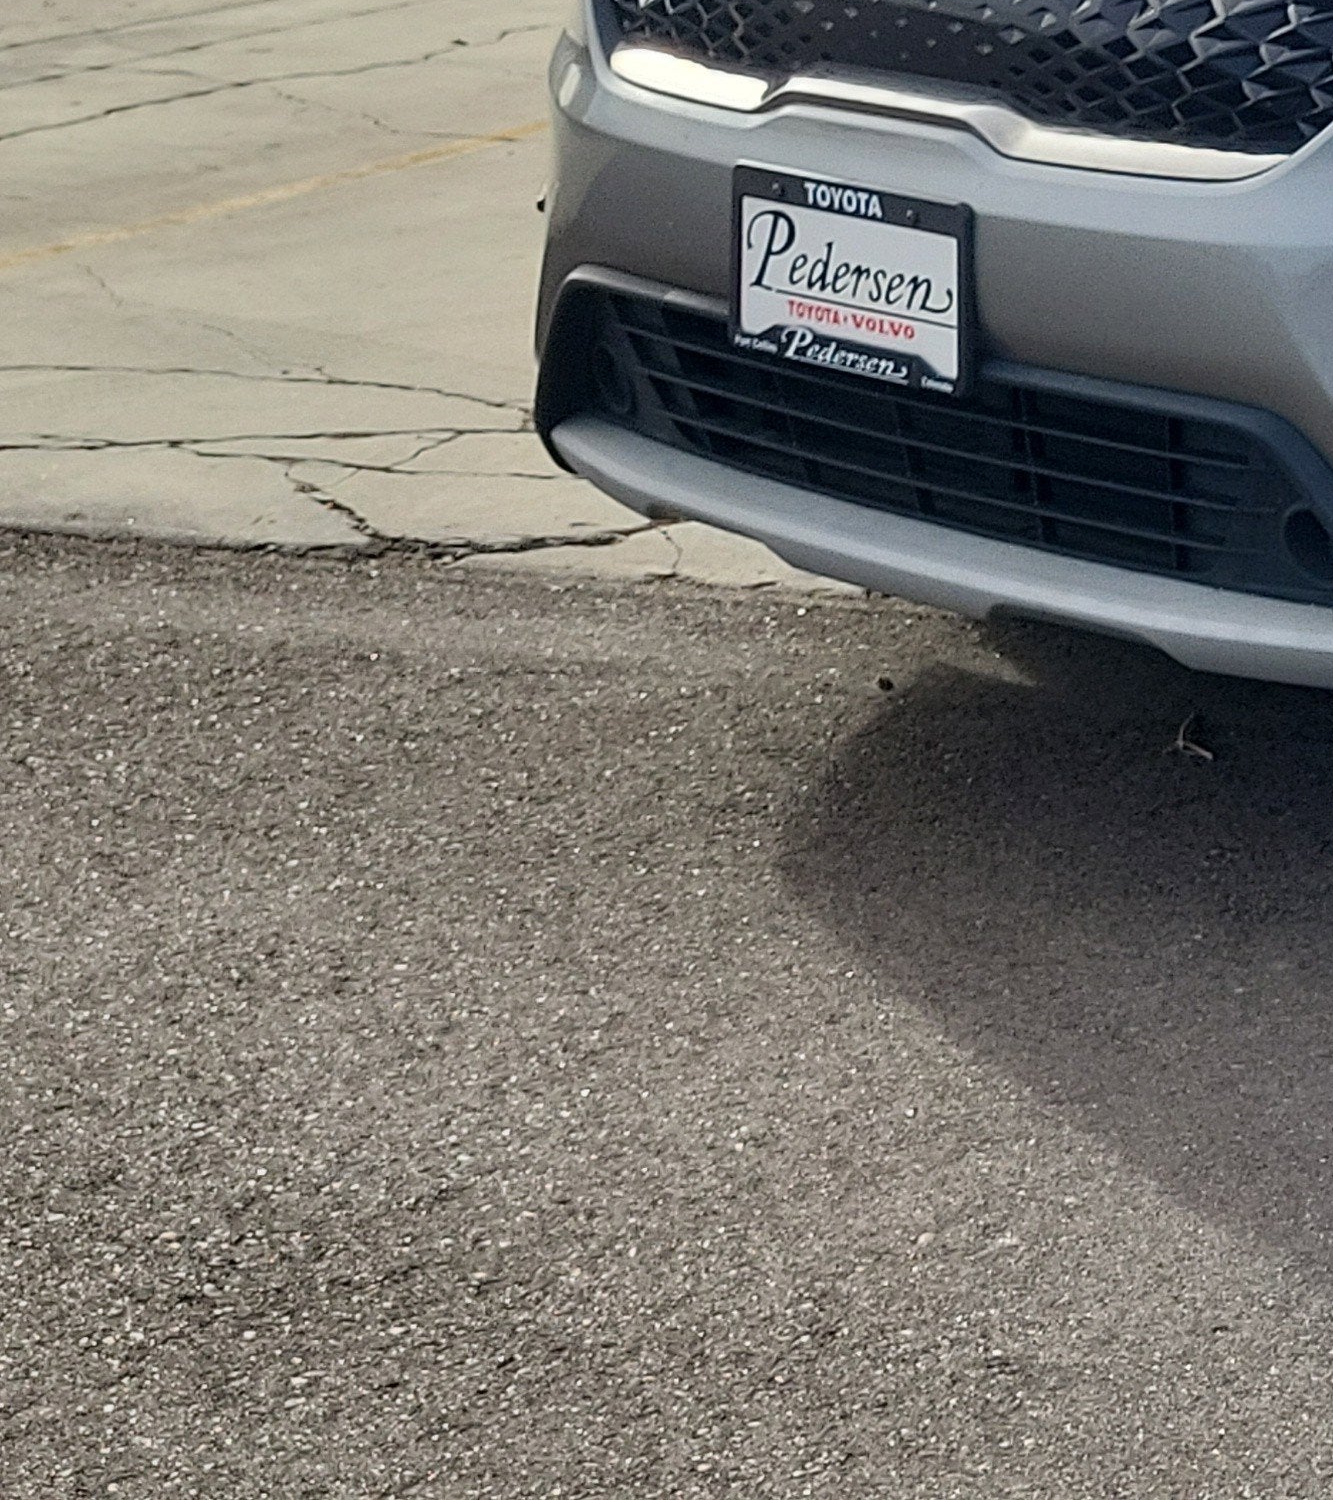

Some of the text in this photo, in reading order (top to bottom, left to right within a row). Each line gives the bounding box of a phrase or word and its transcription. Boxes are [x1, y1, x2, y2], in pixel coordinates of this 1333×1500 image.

[803, 182, 882, 219] TOYOTA
[747, 210, 954, 315] Pedersen
[781, 327, 908, 380] Pedersen
